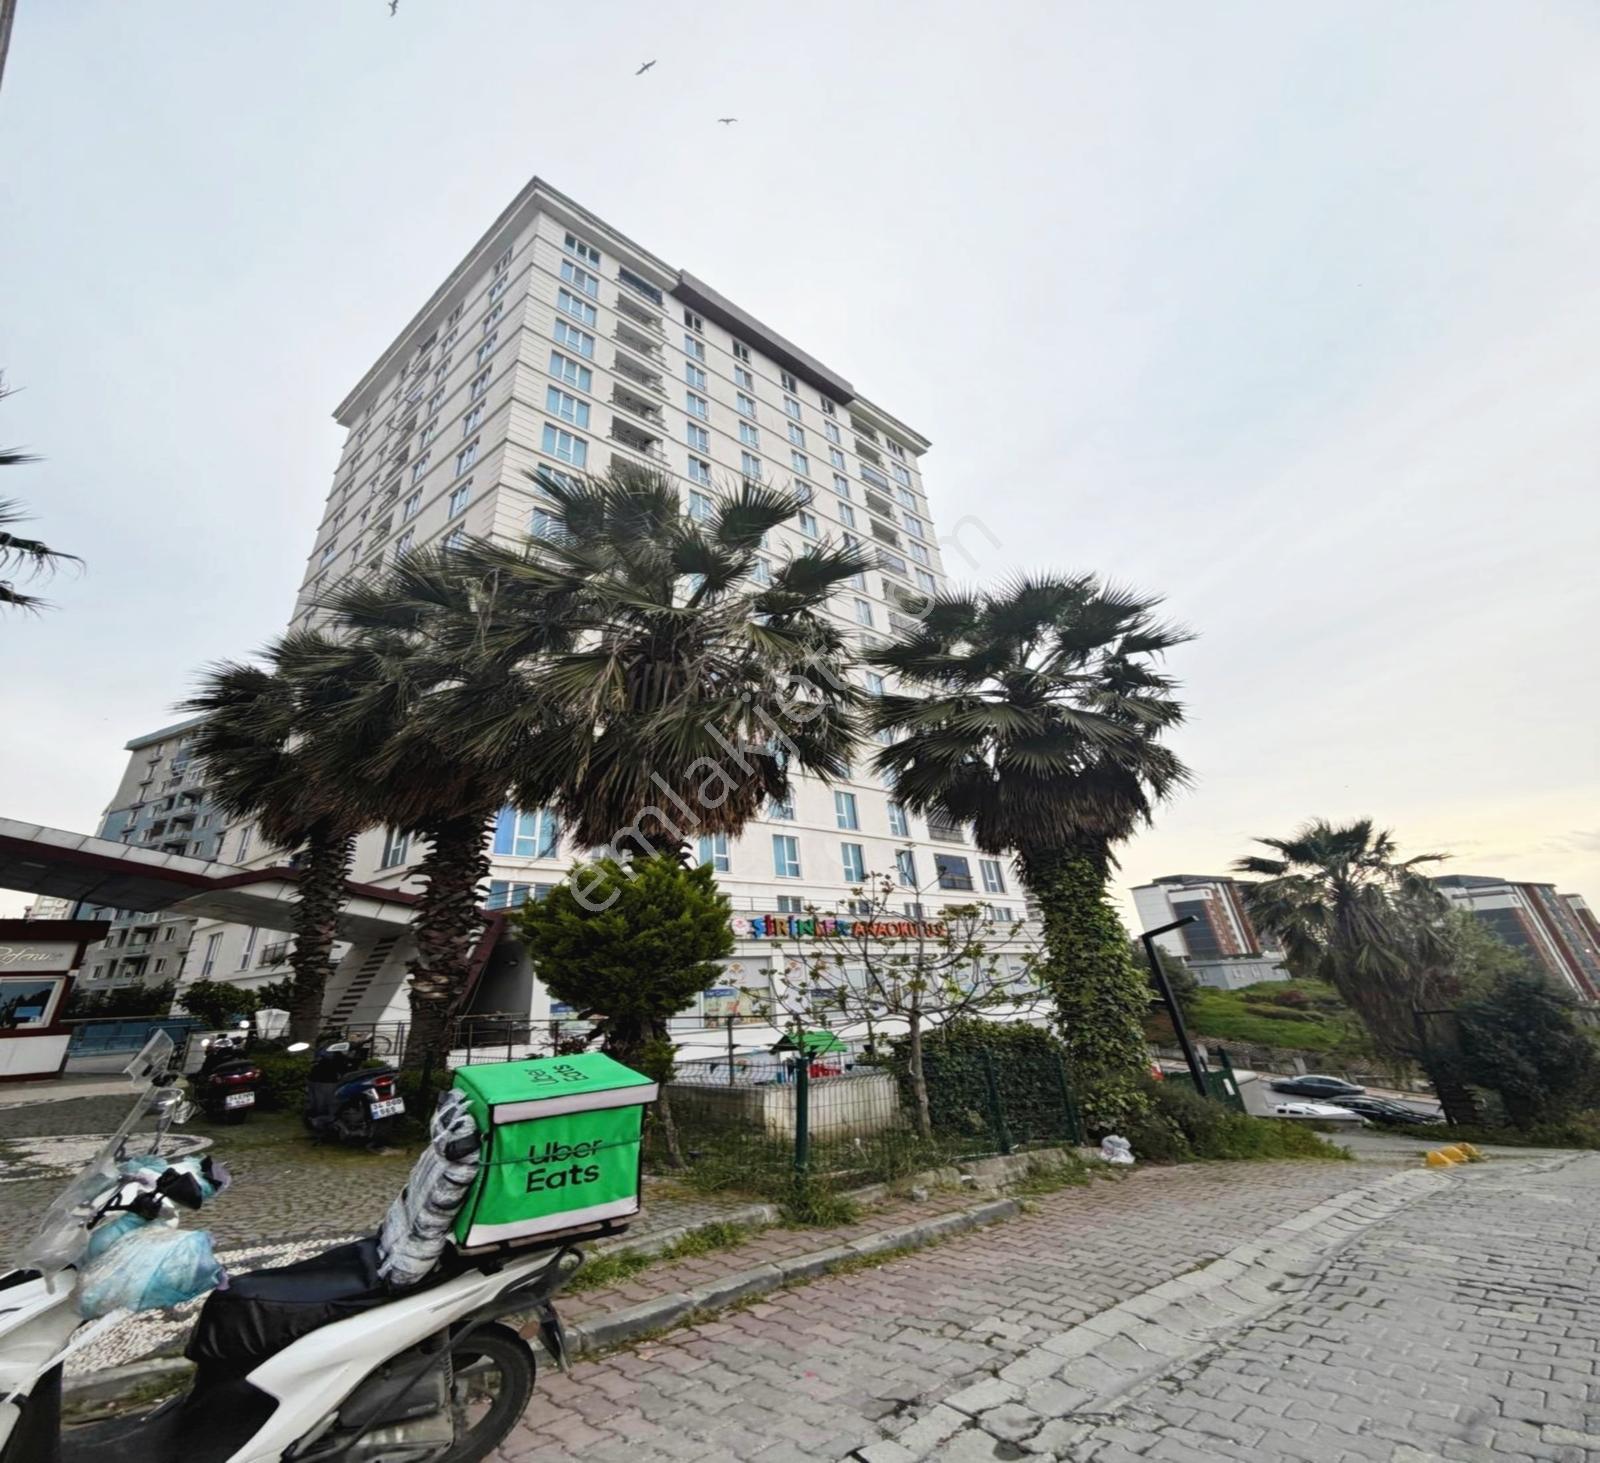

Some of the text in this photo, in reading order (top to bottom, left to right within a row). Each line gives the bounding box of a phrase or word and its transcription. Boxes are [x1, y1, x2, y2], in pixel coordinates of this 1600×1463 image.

[523, 1068, 560, 1087] Uber
[551, 1063, 590, 1082] Eats
[528, 1138, 604, 1166] Uber
[525, 1163, 600, 1194] Eats
